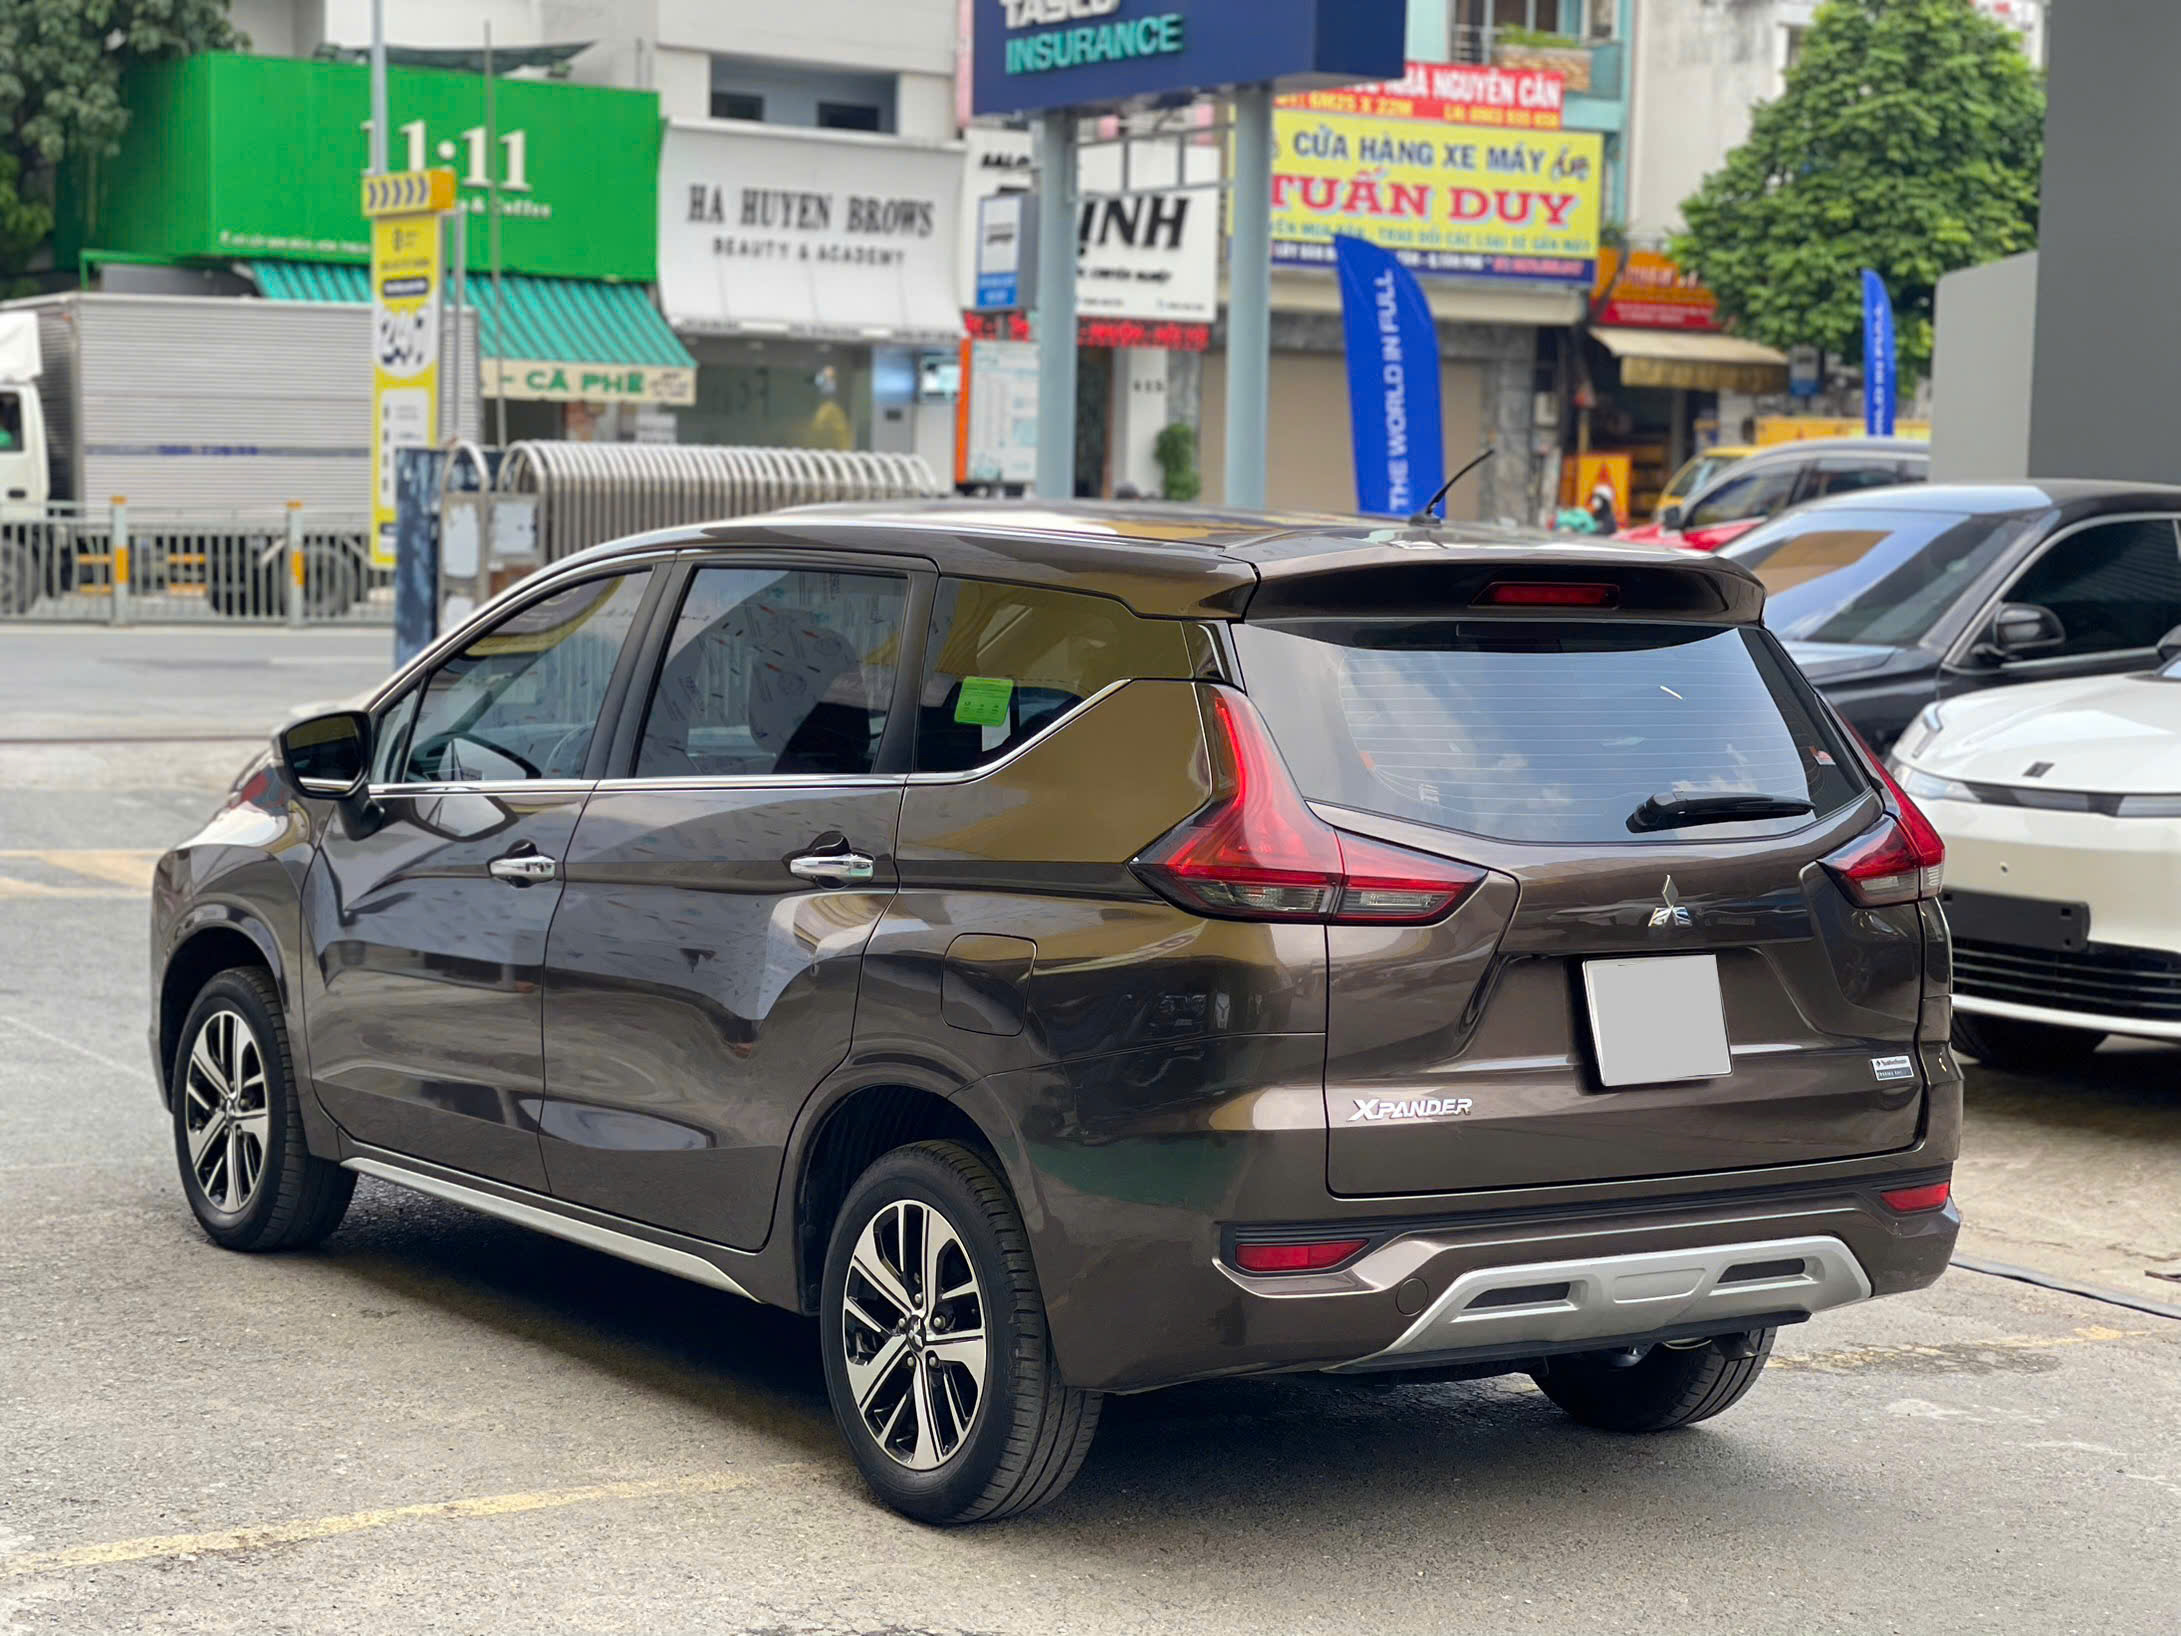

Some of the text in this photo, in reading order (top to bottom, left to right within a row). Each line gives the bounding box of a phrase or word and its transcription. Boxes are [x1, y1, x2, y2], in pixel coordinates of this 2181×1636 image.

[1005, 13, 1184, 75] INSURANCE
[1293, 124, 1548, 175] CỬA HÀNG XE MÁY
[687, 184, 935, 238] HA HUYEN BROWS
[1271, 166, 1574, 227] TUẤN DUY
[713, 236, 791, 258] BEAUTY
[816, 244, 905, 265] ACADEMY
[1373, 268, 1409, 512] THE WORLD IN FULL
[1346, 1098, 1473, 1121] XPANDER
